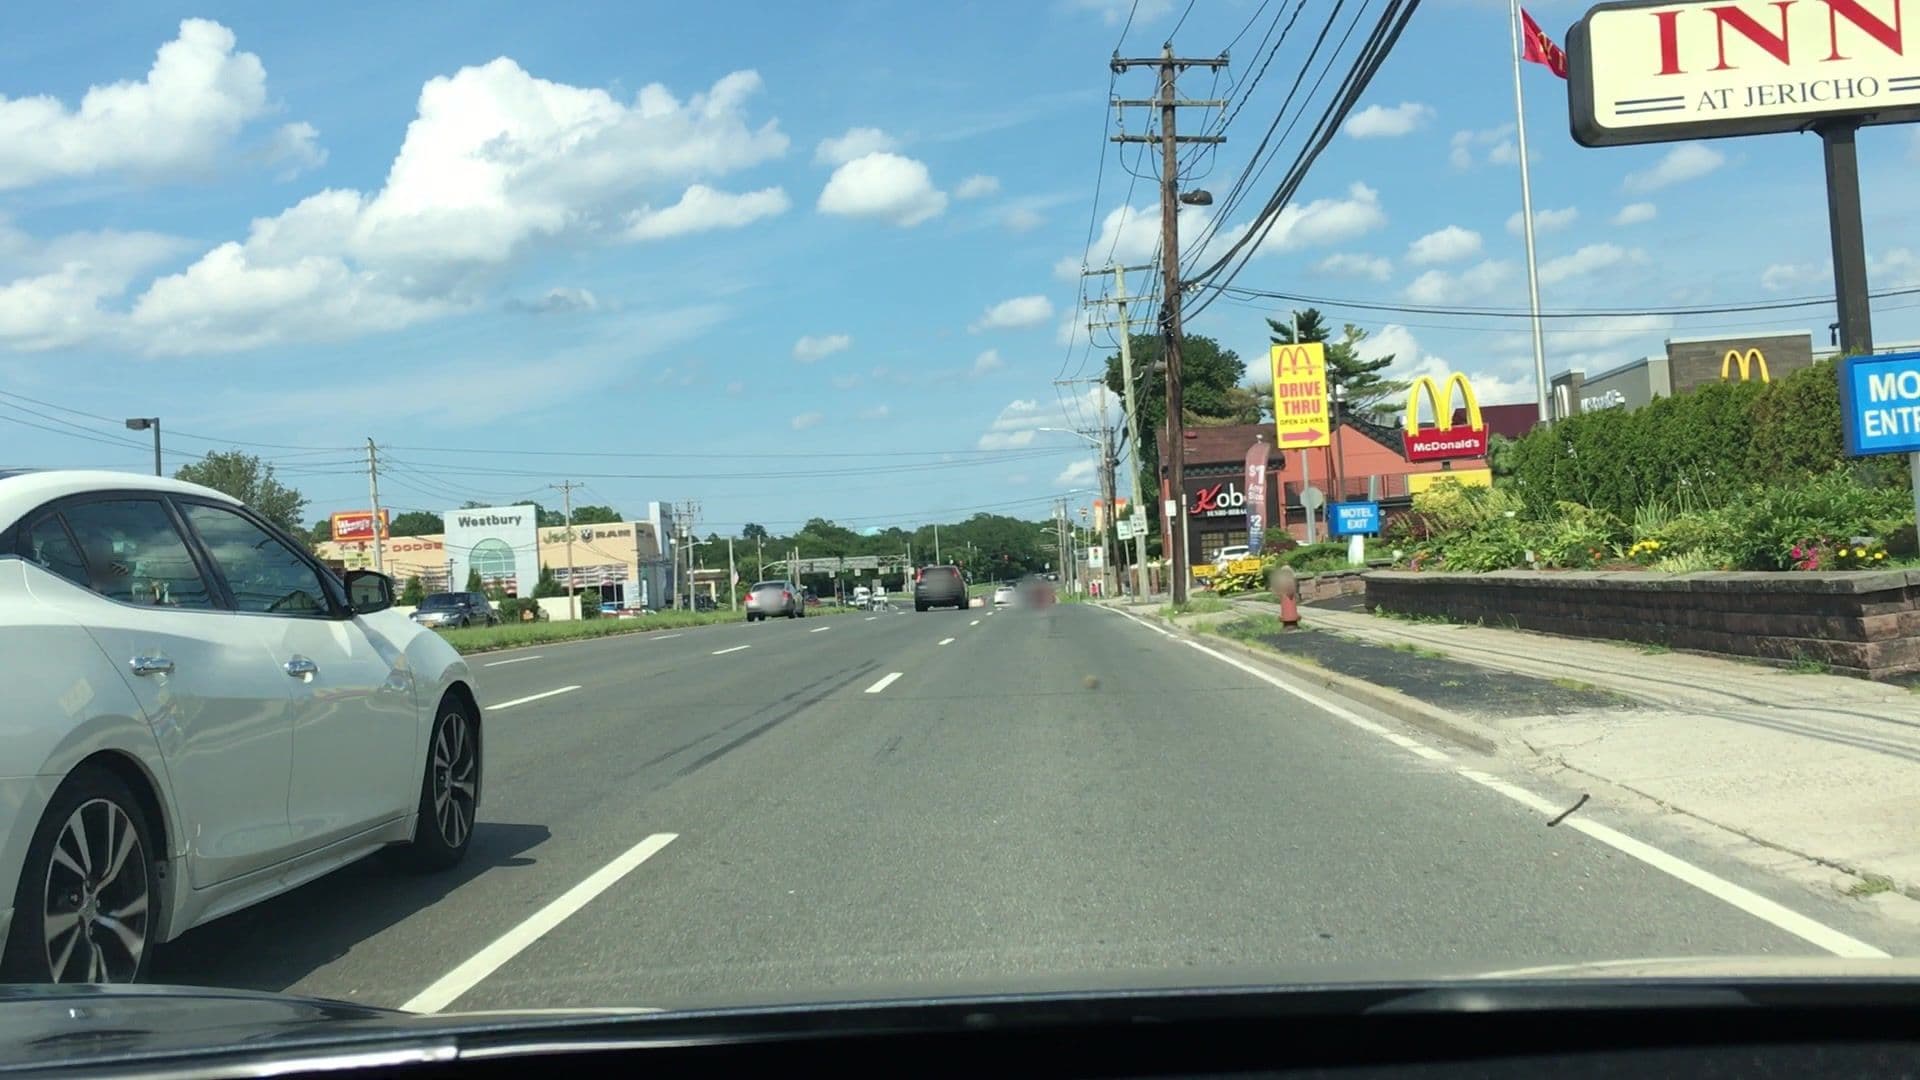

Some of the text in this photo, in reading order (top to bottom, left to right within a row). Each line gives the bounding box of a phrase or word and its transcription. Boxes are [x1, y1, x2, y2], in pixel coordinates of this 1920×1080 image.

[1650, 0, 1904, 76] INN
[1696, 76, 1880, 112] AT JERICHO
[1279, 381, 1322, 398] DRIVE
[1282, 399, 1321, 416] THRU
[1299, 417, 1308, 425] 24
[1413, 438, 1480, 452] McDonald's
[1190, 482, 1246, 514] Kob
[1340, 507, 1373, 518] MOTEL
[457, 513, 522, 529] Westbury
[1347, 518, 1368, 529] EXIT
[595, 529, 631, 538] RAM
[392, 542, 443, 552] DODGE
